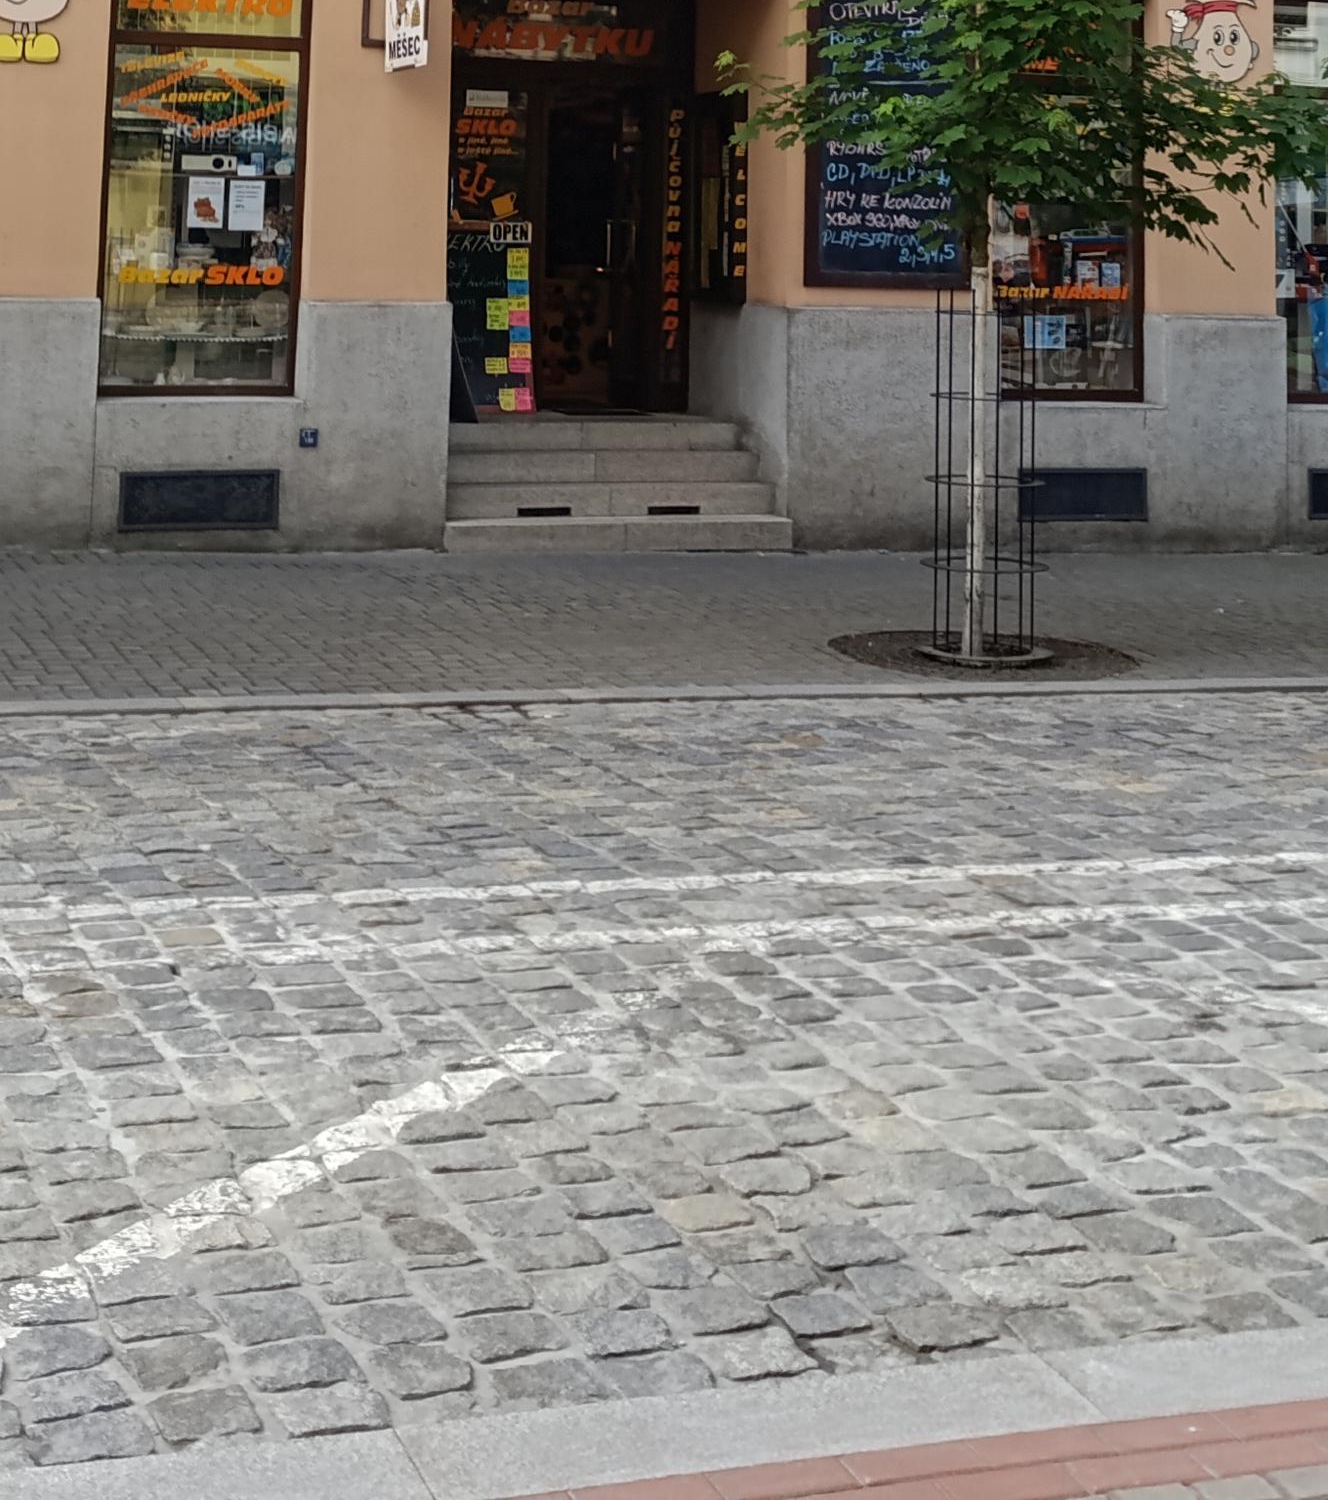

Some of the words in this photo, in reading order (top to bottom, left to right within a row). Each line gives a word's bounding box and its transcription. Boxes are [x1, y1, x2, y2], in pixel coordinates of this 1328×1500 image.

[388, 32, 422, 60] MĚŠEC
[160, 89, 232, 105] LEDNIČKY
[456, 117, 518, 136] SKLO
[825, 189, 857, 210] HRY
[492, 223, 529, 242] OPEN
[821, 230, 920, 250] PLAYSTATION
[119, 267, 204, 285] Bazar
[205, 265, 285, 285] SKLO
